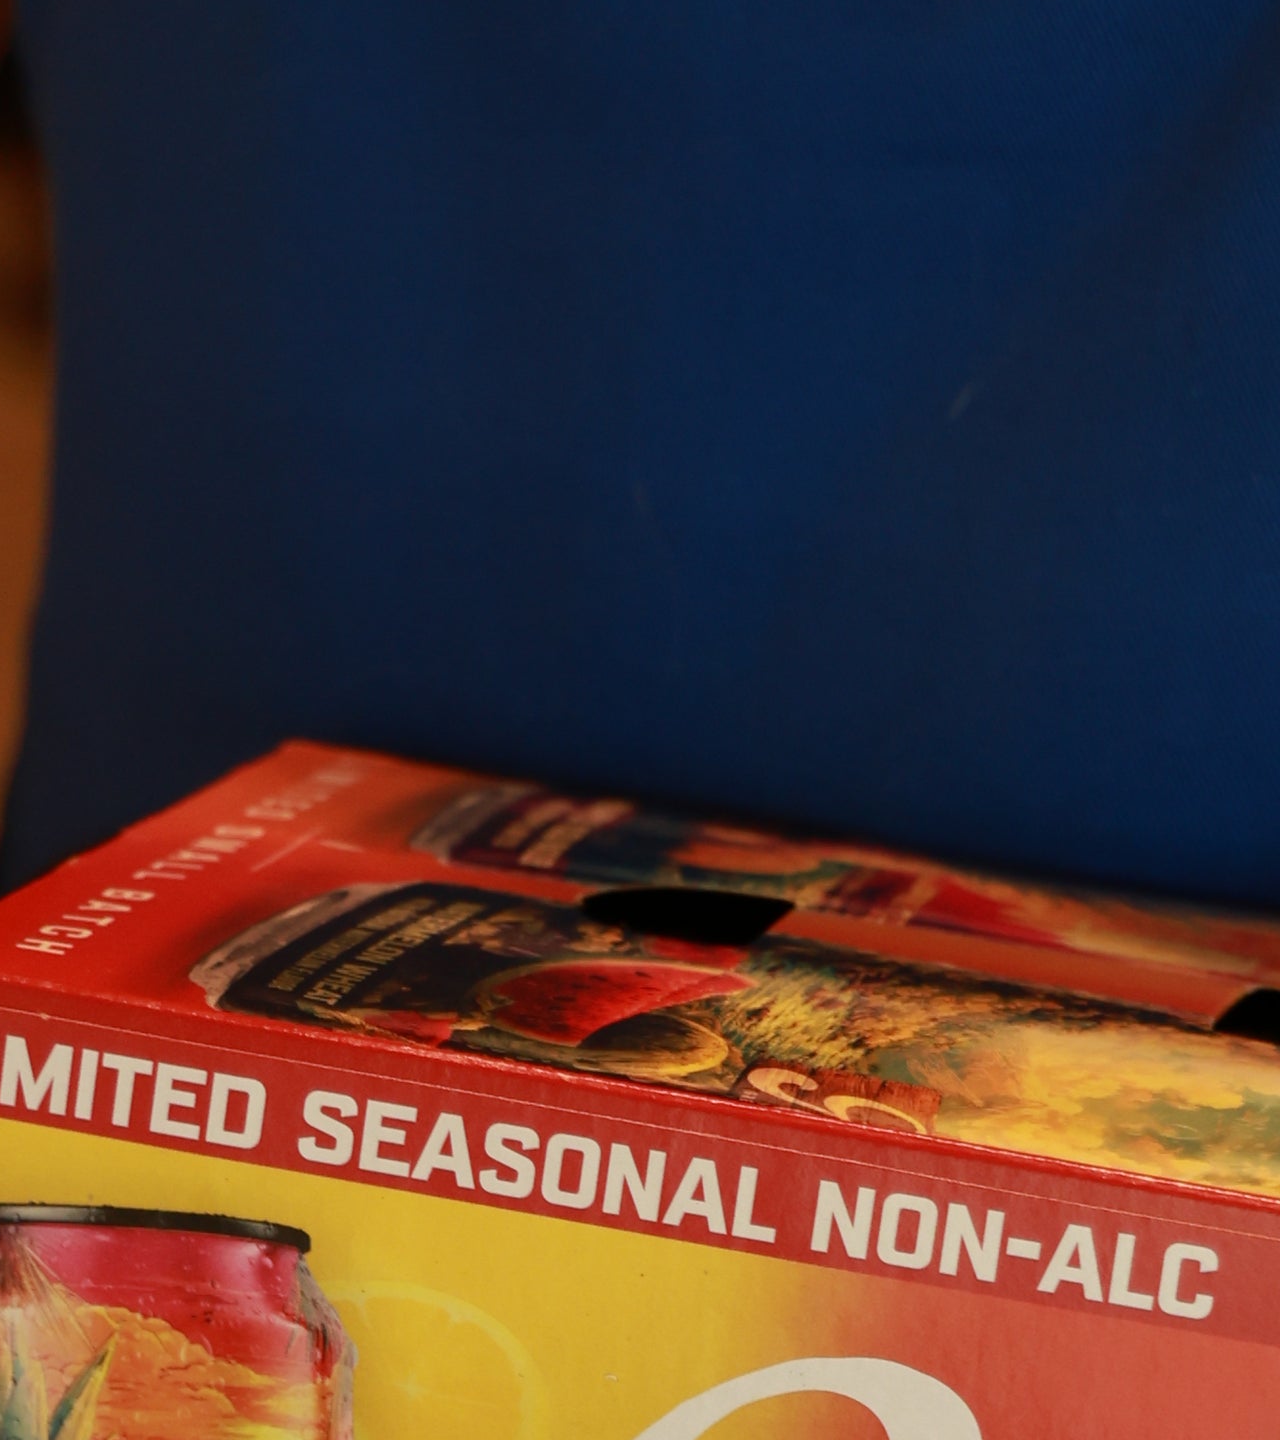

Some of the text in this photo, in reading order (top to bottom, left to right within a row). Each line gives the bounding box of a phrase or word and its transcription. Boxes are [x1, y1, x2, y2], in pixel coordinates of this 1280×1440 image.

[15, 888, 155, 955] BATCH
[297, 1090, 777, 1243] SEASONAL
[810, 1180, 1219, 1320] NON-ALC
